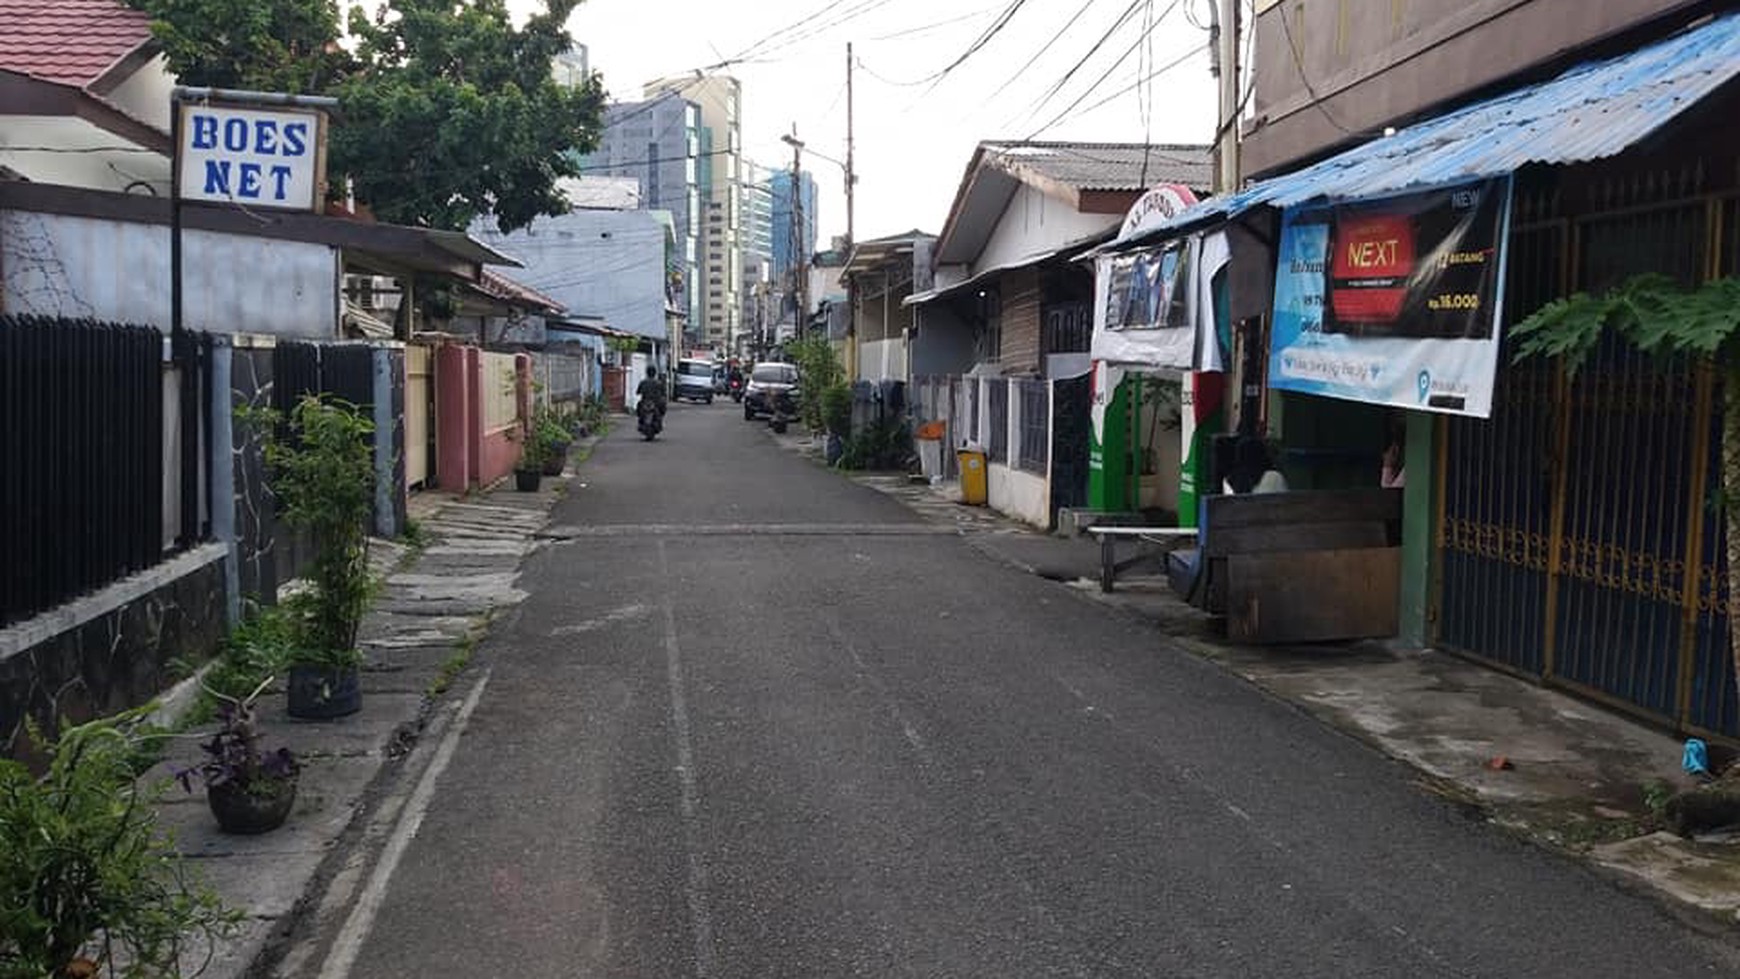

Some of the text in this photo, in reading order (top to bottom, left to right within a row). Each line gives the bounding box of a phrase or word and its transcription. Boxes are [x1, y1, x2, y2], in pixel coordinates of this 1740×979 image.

[191, 115, 307, 157] BOES
[203, 160, 293, 200] NET
[1451, 188, 1480, 208] NEW
[1347, 239, 1399, 268] NEXT
